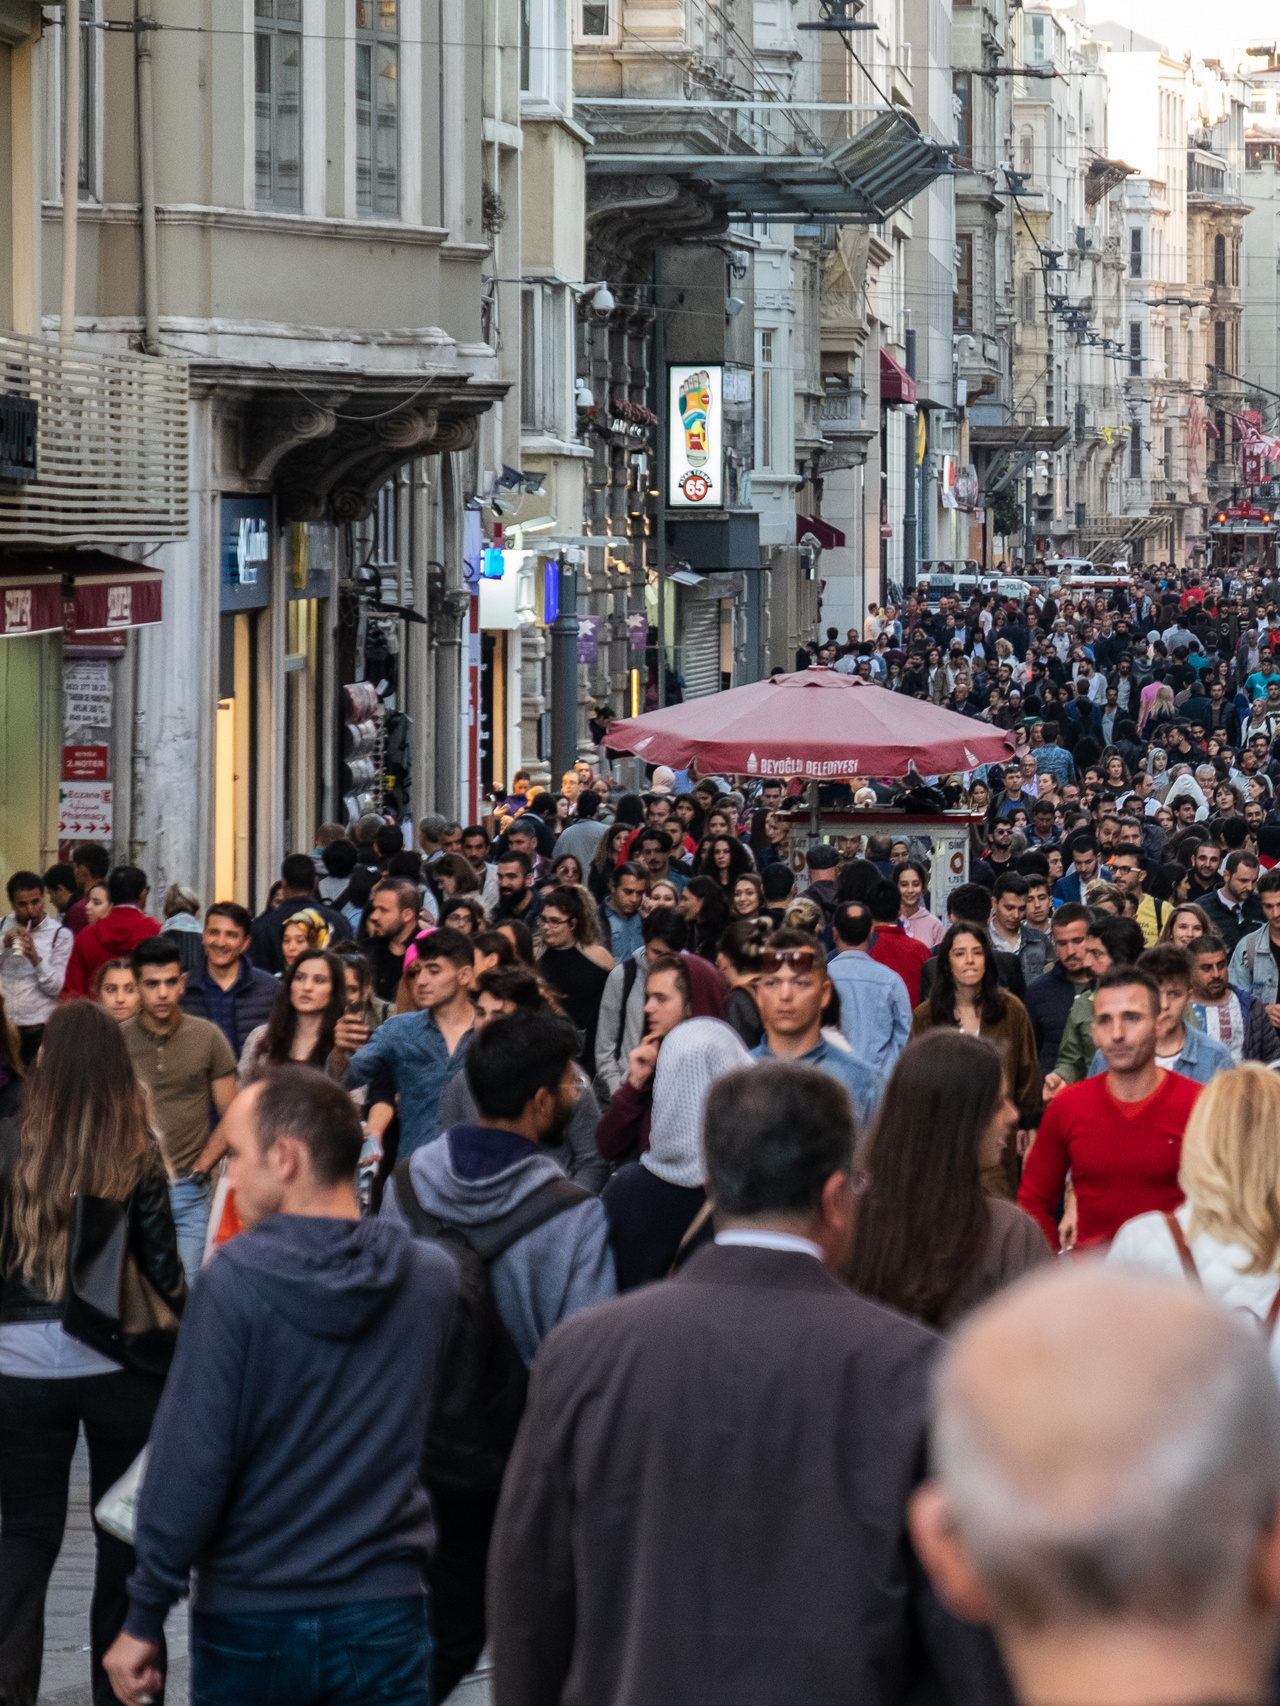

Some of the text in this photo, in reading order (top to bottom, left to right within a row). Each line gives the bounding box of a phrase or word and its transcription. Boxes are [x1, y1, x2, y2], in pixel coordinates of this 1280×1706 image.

[685, 479, 705, 496] 65
[761, 757, 859, 776] BEYOĞLU BELEDİYESİ
[68, 790, 101, 799] Eczane
[62, 811, 107, 822] Pharmacy
[948, 839, 966, 850] SİMT
